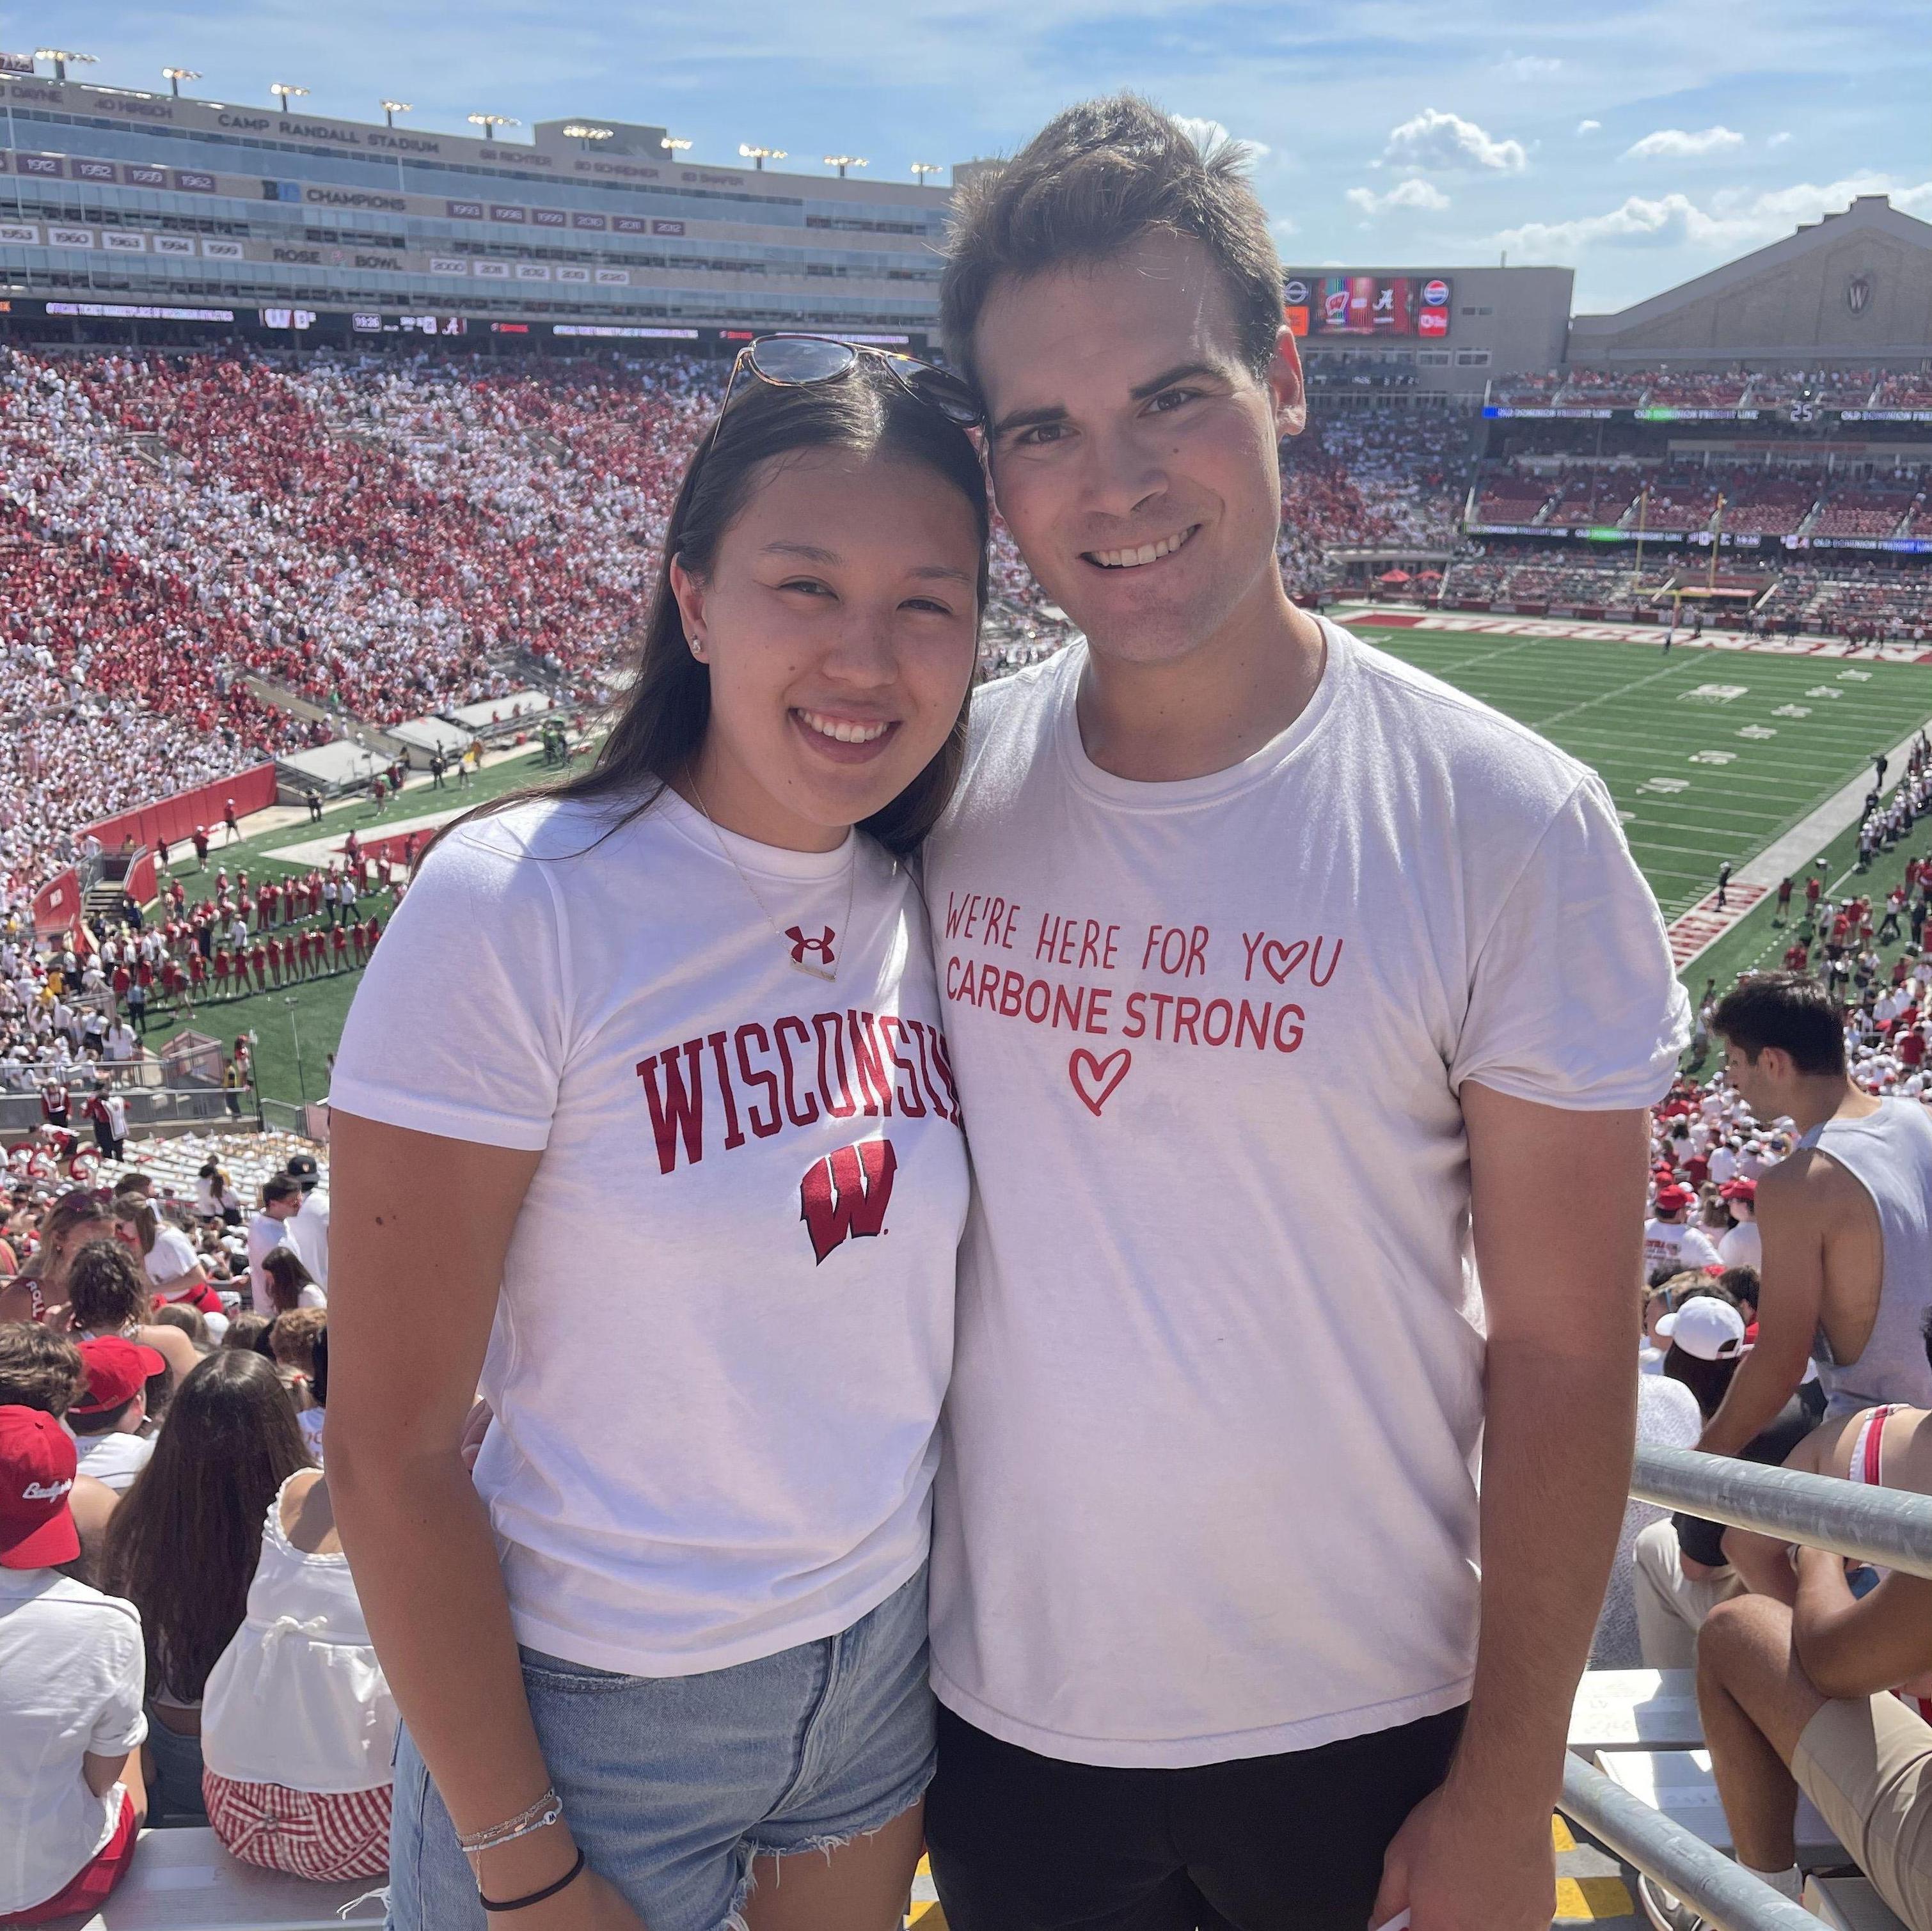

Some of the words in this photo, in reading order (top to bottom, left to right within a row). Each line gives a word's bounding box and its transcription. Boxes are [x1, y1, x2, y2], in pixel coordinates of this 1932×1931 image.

[218, 114, 269, 129] CAMP
[279, 122, 360, 144] RANDALL
[368, 134, 439, 154] STADIUM
[28, 158, 56, 172] 1912
[80, 164, 113, 177] 1952
[132, 169, 163, 184] 1959
[181, 175, 212, 189] 1962
[306, 189, 406, 212] CHAMPIONS
[273, 248, 321, 263] ROSE
[355, 255, 402, 271] BOWL
[1790, 404, 1813, 422] 25
[945, 891, 1020, 949] WE'RE
[1035, 913, 1121, 970] HERE
[1142, 925, 1210, 978] FOR
[946, 956, 1112, 1035] CARBONE
[1121, 992, 1306, 1053] STRONG
[800, 1139, 898, 1267] W
[26, 1281, 45, 1318] ROLL
